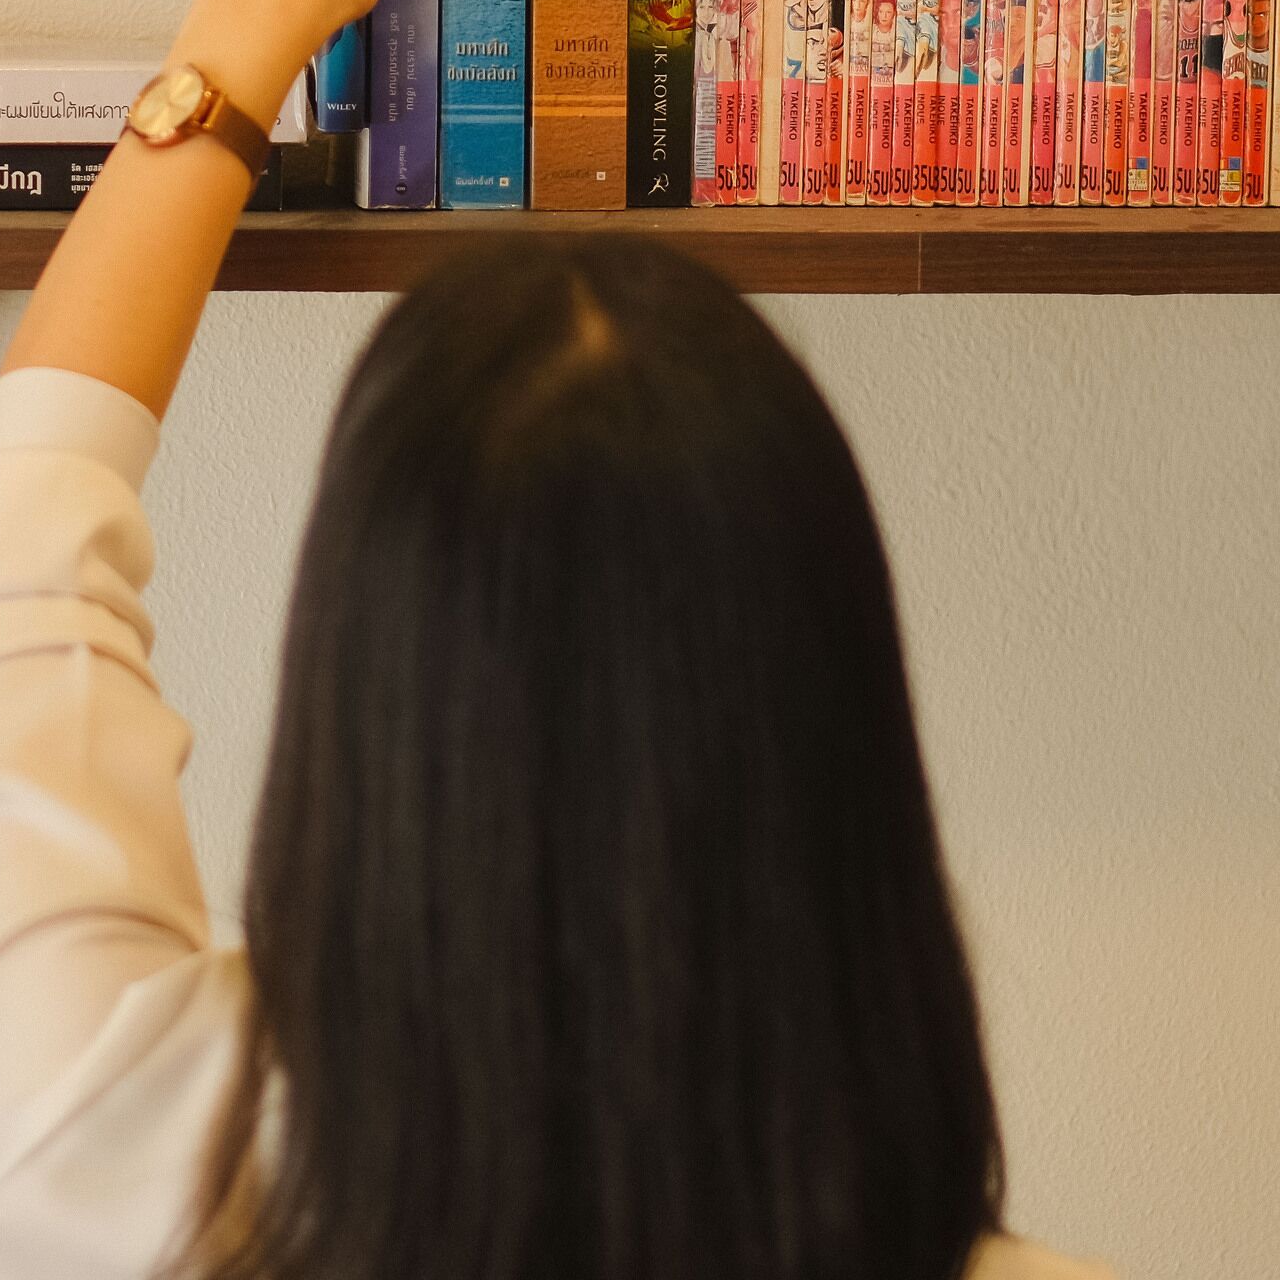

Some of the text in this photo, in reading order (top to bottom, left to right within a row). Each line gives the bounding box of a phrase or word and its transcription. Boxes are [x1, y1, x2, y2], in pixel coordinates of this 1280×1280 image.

[326, 103, 357, 112] WILEY
[651, 42, 668, 161] J.K. ROWLING
[881, 99, 890, 149] TAKEHIKO
[949, 96, 959, 145] TAKEHIKO
[1114, 99, 1123, 149] TAKEHIKO
[1184, 96, 1193, 147] TAKEHIKO
[1231, 92, 1241, 142] TAKEHIKO
[1253, 103, 1262, 152] TAKEHIKO
